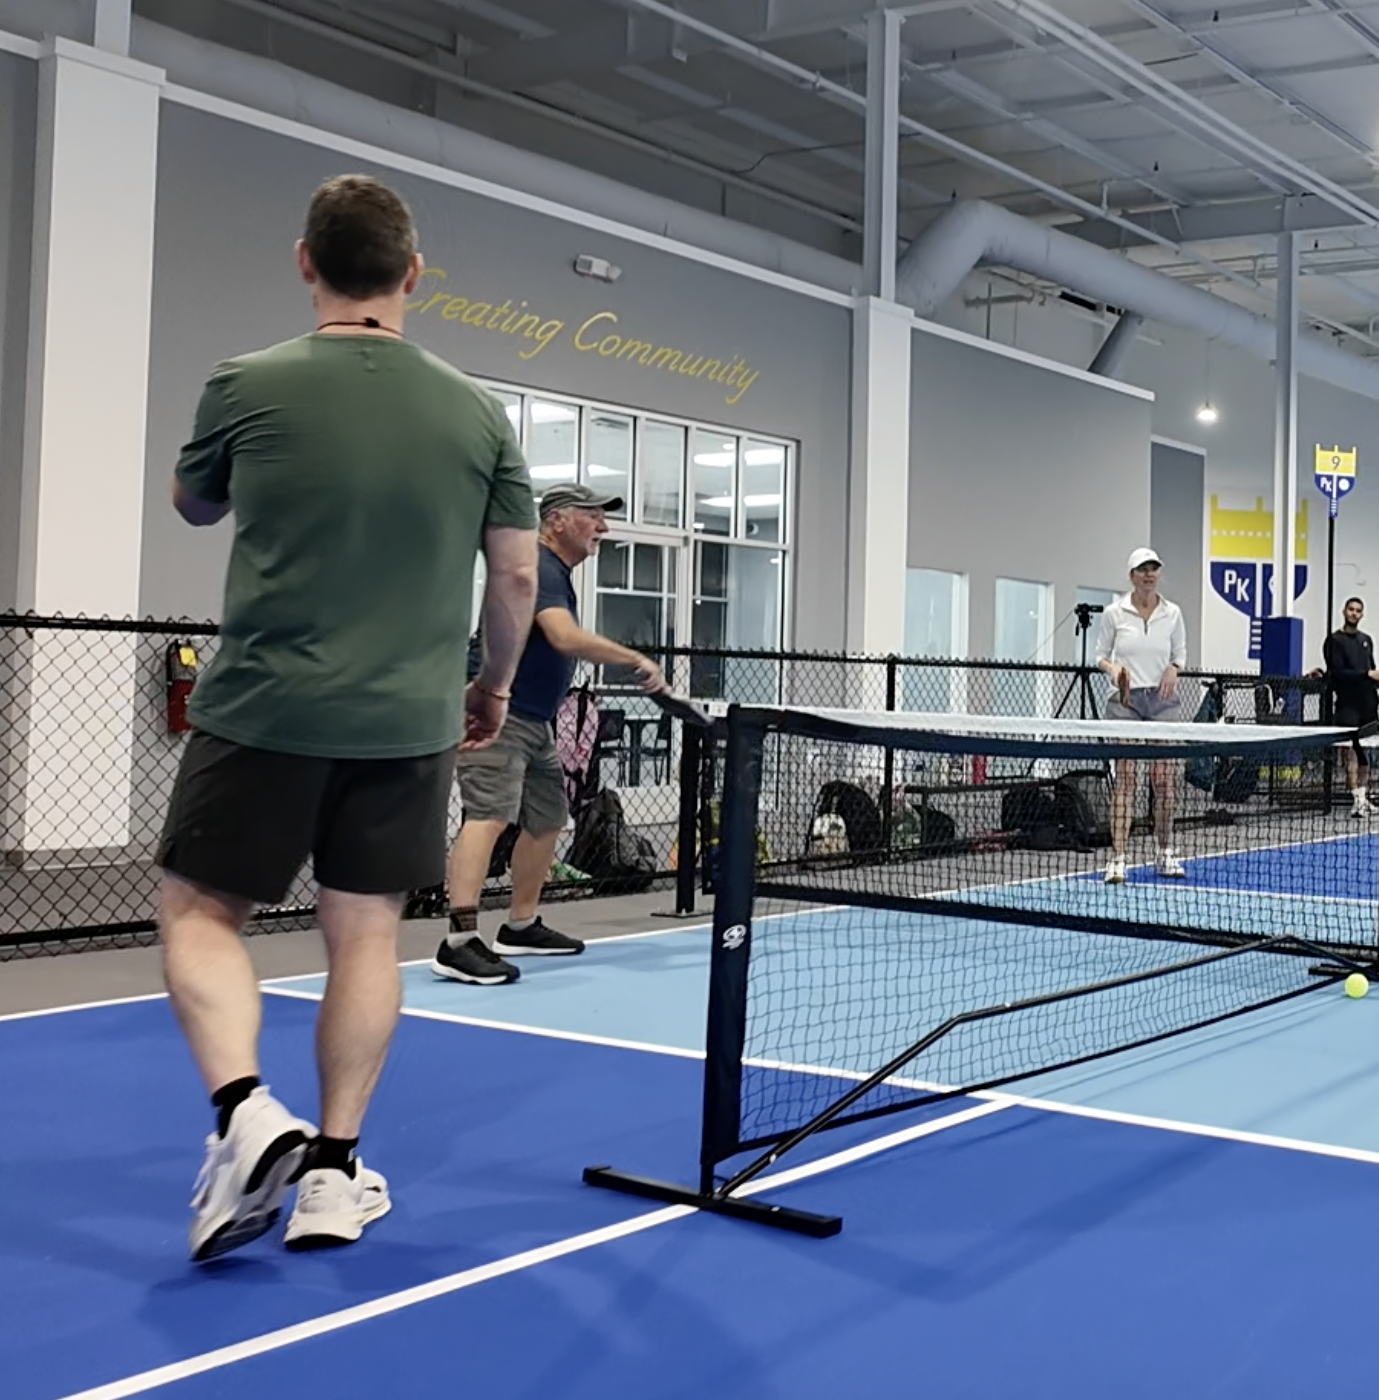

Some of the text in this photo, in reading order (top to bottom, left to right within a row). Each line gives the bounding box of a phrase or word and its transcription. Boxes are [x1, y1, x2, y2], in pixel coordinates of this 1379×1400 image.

[404, 267, 760, 405] Creating Community
[1332, 455, 1341, 471] 9
[1224, 569, 1250, 602] PK
